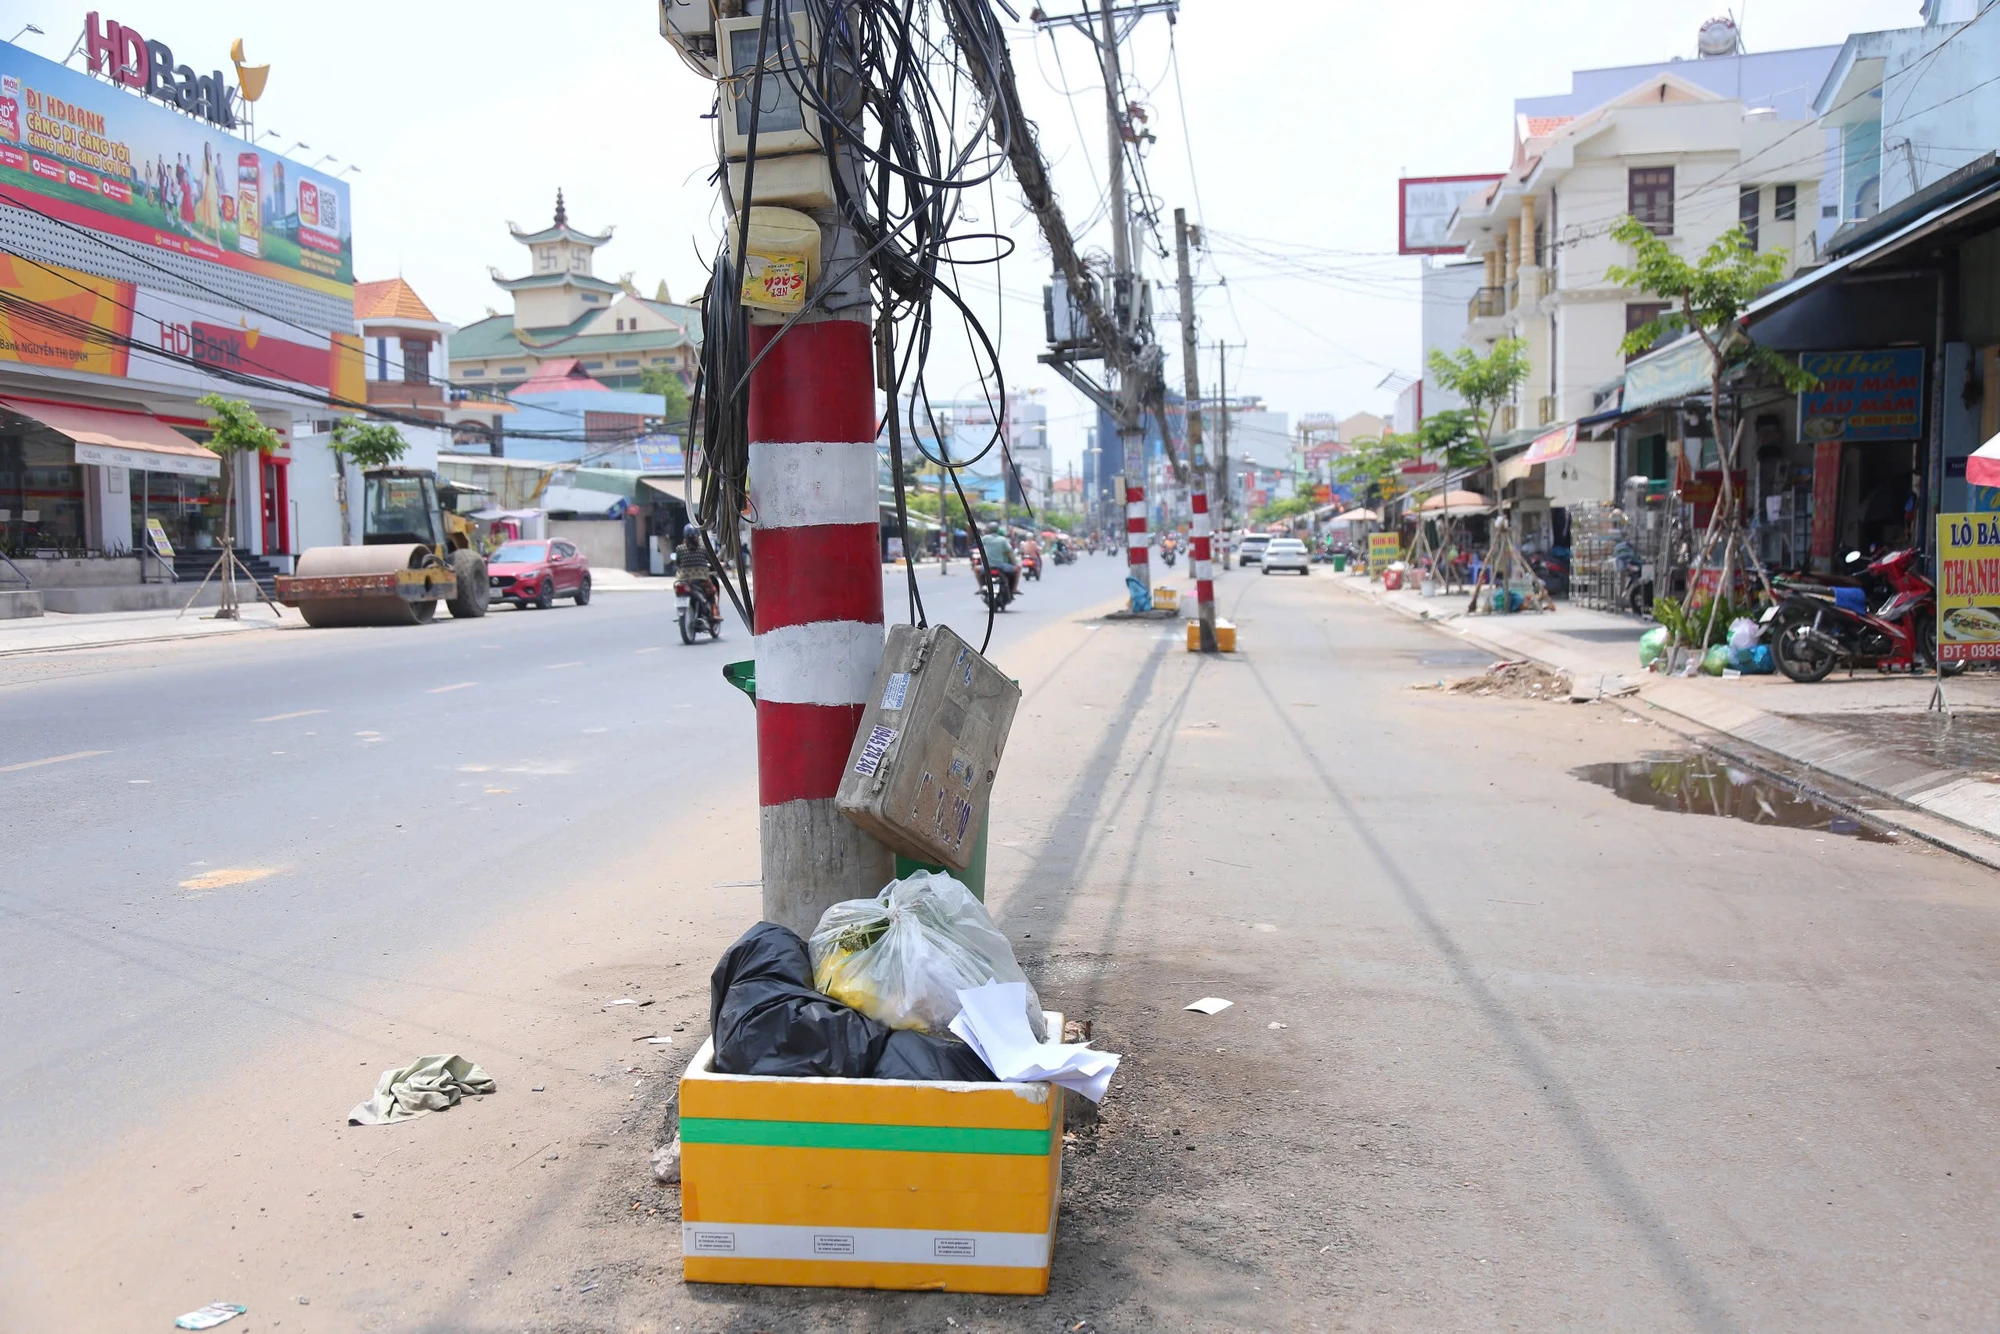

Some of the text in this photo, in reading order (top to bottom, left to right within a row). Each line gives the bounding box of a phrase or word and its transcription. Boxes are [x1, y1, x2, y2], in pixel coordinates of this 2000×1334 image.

[85, 11, 237, 129] HDBank
[46, 95, 106, 135] HDBANK
[26, 111, 130, 165] CÀNG ĐI CÀNG TỚI
[27, 132, 54, 152] CÀNG
[56, 141, 75, 161] MỚI
[76, 146, 101, 169] CÀNG
[770, 287, 788, 298] NET
[160, 319, 242, 367] HDBank
[1951, 517, 1974, 547] LÒ
[1943, 558, 2000, 608] THẠNH
[1943, 643, 2000, 659] ĐT: 0938
